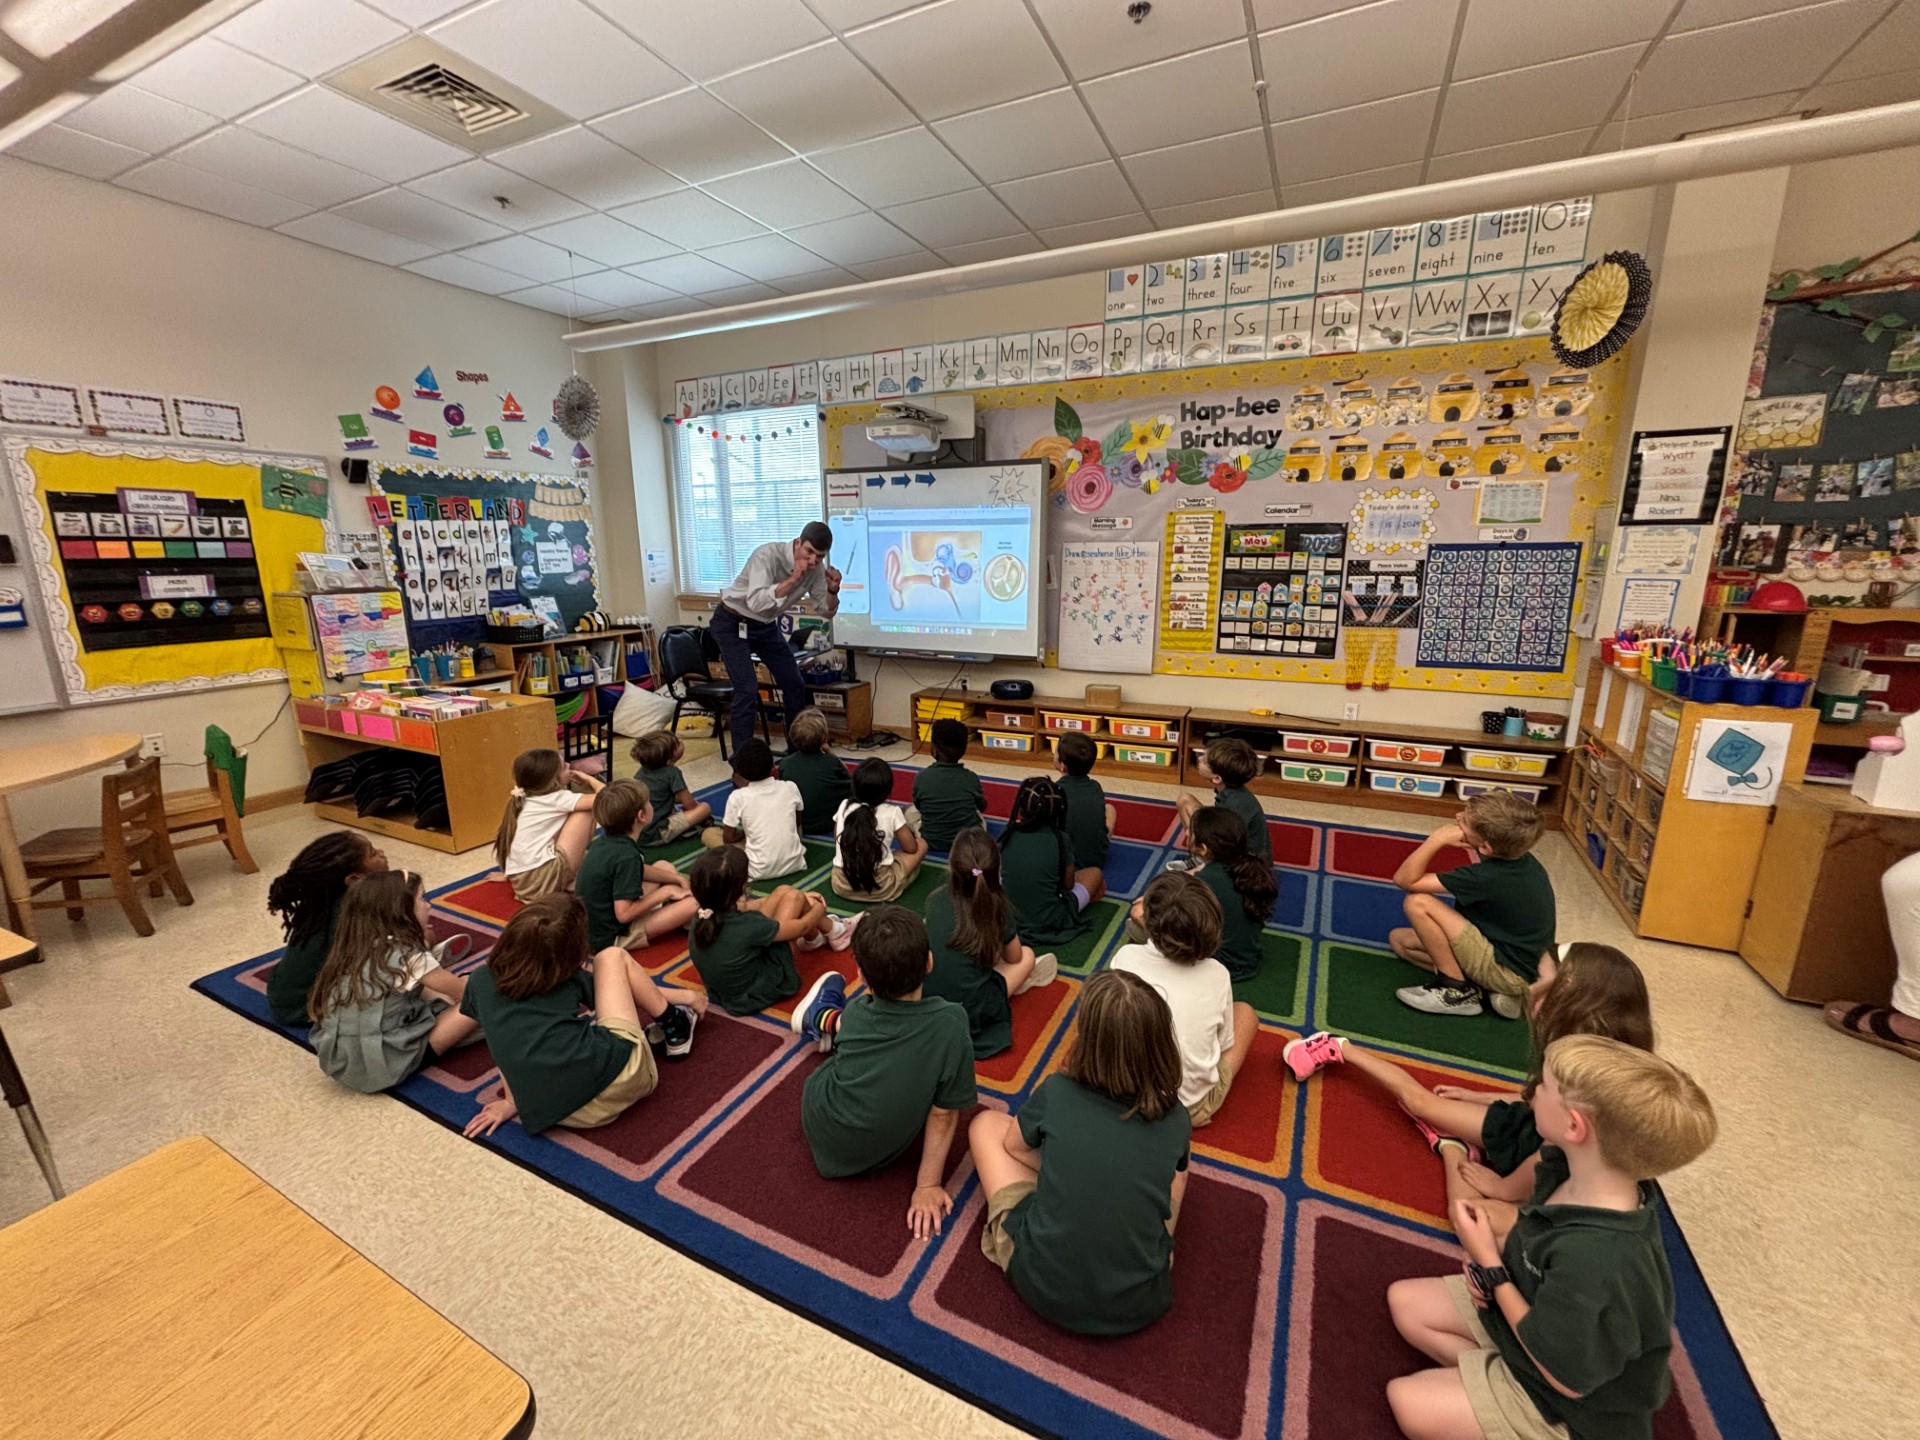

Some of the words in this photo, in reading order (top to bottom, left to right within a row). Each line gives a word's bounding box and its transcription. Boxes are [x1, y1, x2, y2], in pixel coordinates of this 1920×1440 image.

[1148, 265, 1160, 288] 2
[1188, 259, 1198, 282] 3
[1232, 252, 1249, 275] 4
[1276, 245, 1288, 269] 5
[1323, 236, 1340, 262] 6
[1372, 229, 1392, 256] 7
[1427, 223, 1442, 248] 8
[1490, 215, 1502, 239] 9
[1534, 202, 1568, 234] 10
[1107, 302, 1126, 312] one
[1146, 295, 1164, 306] two
[1188, 288, 1216, 301] three
[1230, 282, 1252, 296] four
[1274, 275, 1294, 290] five
[1320, 272, 1336, 284] six
[1368, 265, 1404, 278] seven
[1420, 252, 1454, 276] eight
[1474, 251, 1503, 264] nine
[1532, 241, 1554, 256] ten
[679, 386, 694, 402] Aa
[702, 382, 716, 398] Bb
[725, 378, 738, 396] Cc
[749, 376, 764, 393] Dd
[773, 372, 790, 390] Ee
[800, 366, 815, 386] Ff
[822, 364, 842, 392] Gg
[850, 360, 870, 380] Hh
[882, 357, 894, 376] Ii
[911, 352, 928, 382] Jj
[939, 348, 960, 369] Kk
[1000, 341, 1029, 363] Mm
[1037, 336, 1060, 360] Nn
[1070, 332, 1098, 354] Oo
[1114, 328, 1132, 362] Pp
[1146, 322, 1180, 356] Qq
[1192, 318, 1217, 341] Rr
[1233, 312, 1256, 336] Ss
[1277, 306, 1300, 331] Tt
[1321, 301, 1351, 327] Uu
[1372, 296, 1400, 321] Vv
[1414, 288, 1462, 317] Ww
[1474, 282, 1510, 310] Xx
[456, 370, 488, 384] Shapes
[1180, 396, 1280, 426] Hap-bee
[1180, 425, 1282, 450] Birthday
[1663, 452, 1696, 461] Wyatt
[1662, 467, 1687, 475] Jack
[1004, 480, 1012, 494] 6
[374, 500, 522, 520] LETTERLAND
[402, 530, 412, 540] a
[420, 525, 430, 540] b
[438, 530, 448, 540] c
[452, 524, 462, 539] d
[468, 529, 478, 538] e
[1244, 537, 1268, 546] May
[1303, 536, 1341, 552] 2025
[406, 550, 417, 566] h
[456, 547, 468, 565] k
[486, 552, 496, 562] m
[1116, 547, 1130, 558] like
[408, 580, 418, 589] o
[428, 578, 438, 592] p
[444, 578, 455, 591] q
[476, 576, 482, 585] s
[412, 598, 424, 612] v
[432, 600, 444, 612] w
[449, 599, 459, 614] x
[463, 597, 472, 612] y
[479, 598, 486, 608] z
